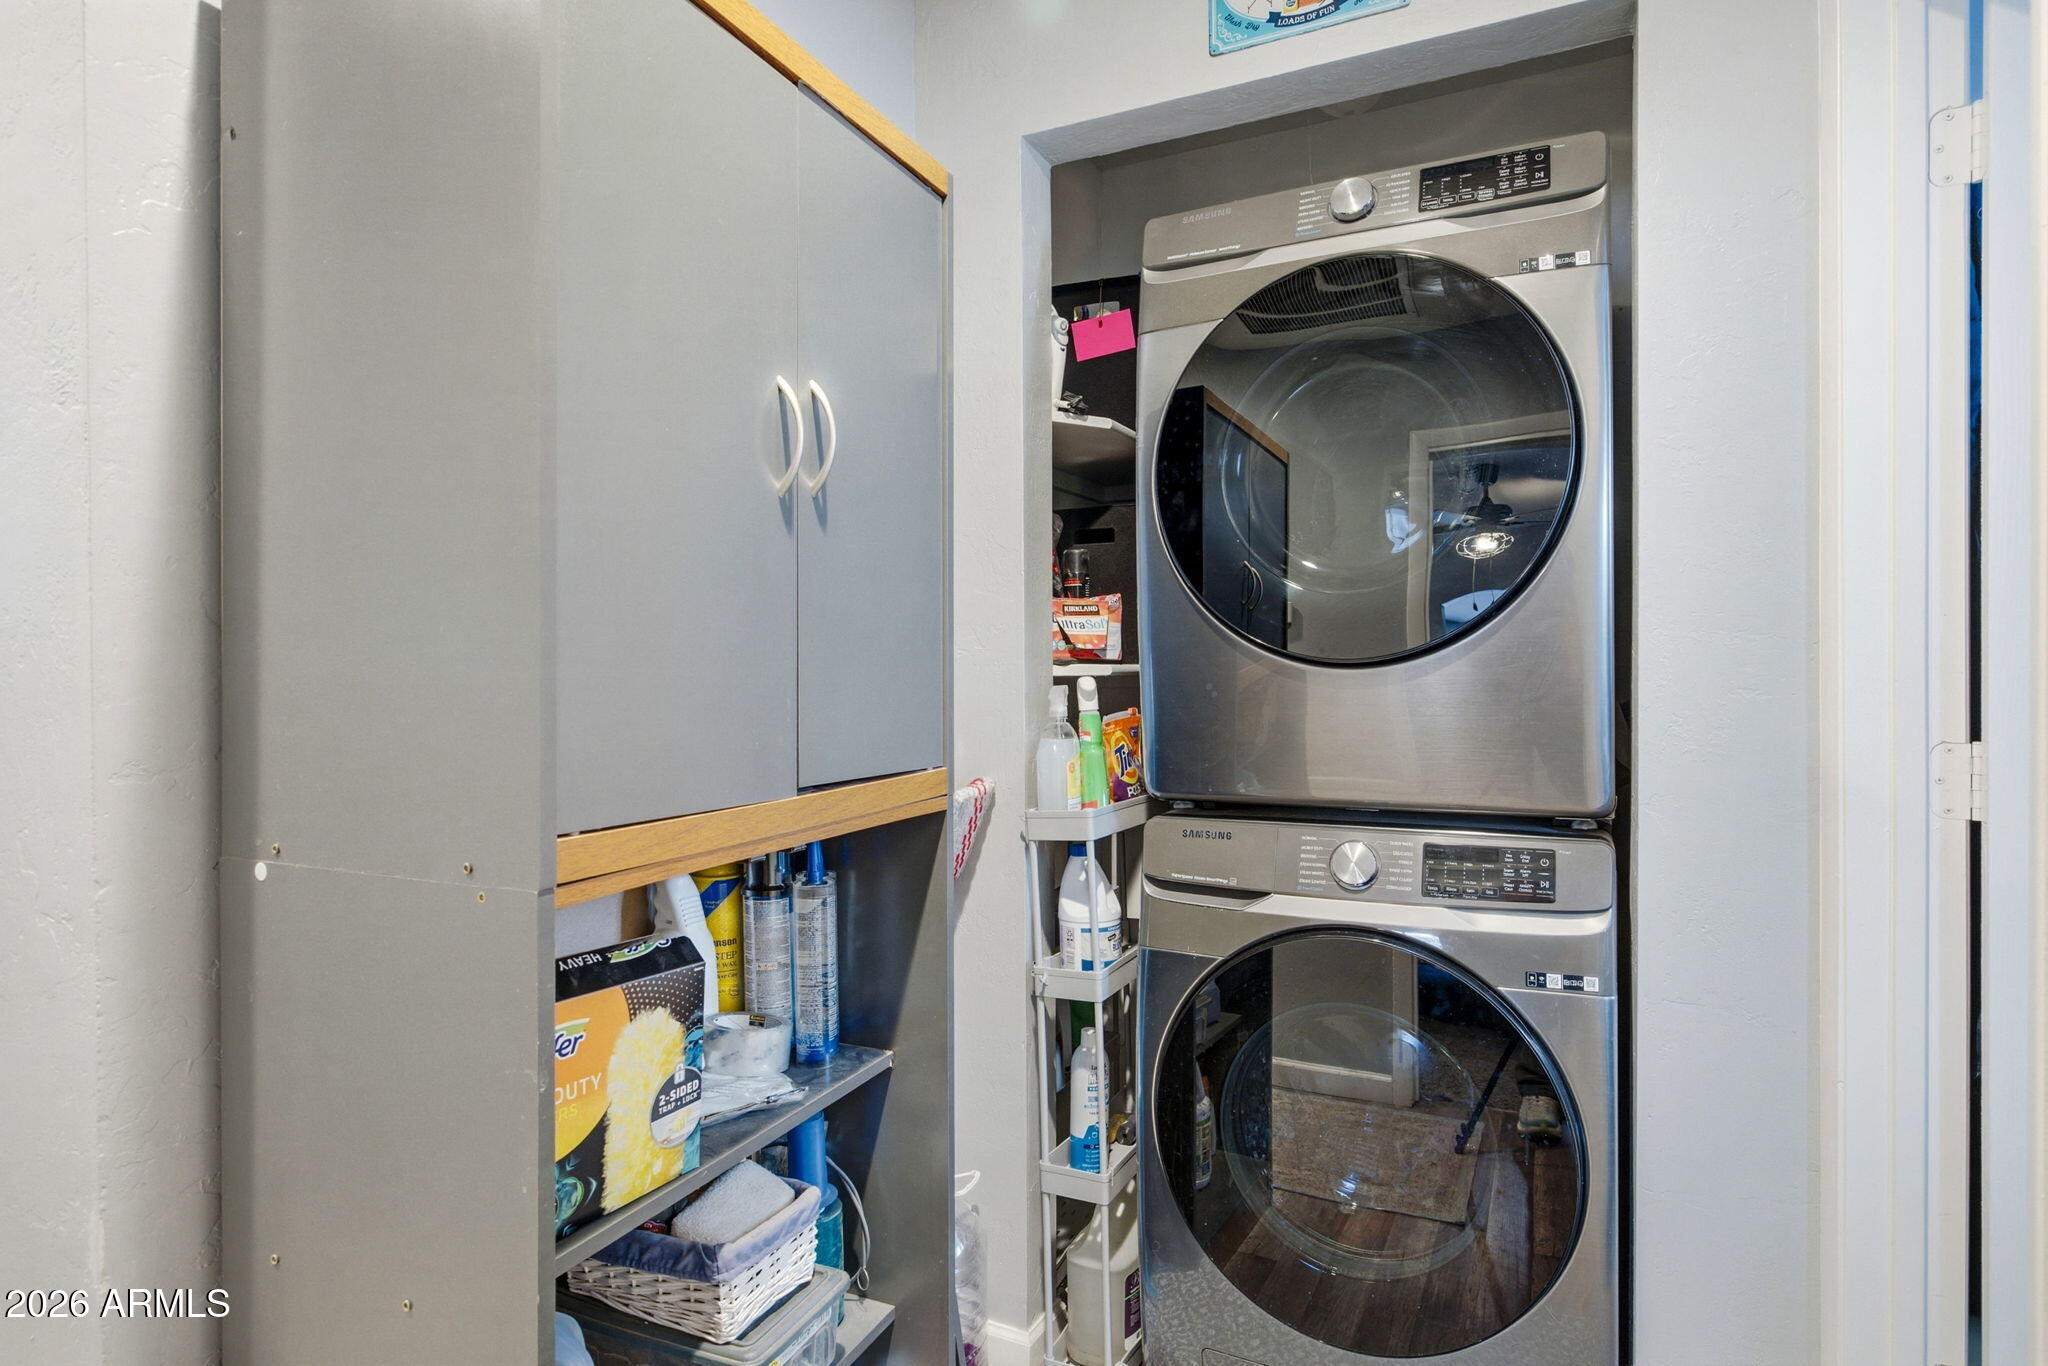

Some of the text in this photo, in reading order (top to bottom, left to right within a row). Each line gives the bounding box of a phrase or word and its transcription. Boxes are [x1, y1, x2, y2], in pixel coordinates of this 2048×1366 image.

[1277, 5, 1336, 26] LOADS OF FUN
[1182, 207, 1232, 224] SAMSUNG
[1182, 829, 1232, 840] SAMSUNG
[558, 953, 602, 971] HEAVY
[722, 961, 737, 969] WAX
[555, 1072, 602, 1105] DUTY
[658, 1079, 699, 1108] 2-SIDED
[659, 1101, 676, 1116] TRAP
[682, 1091, 698, 1104] LOCK
